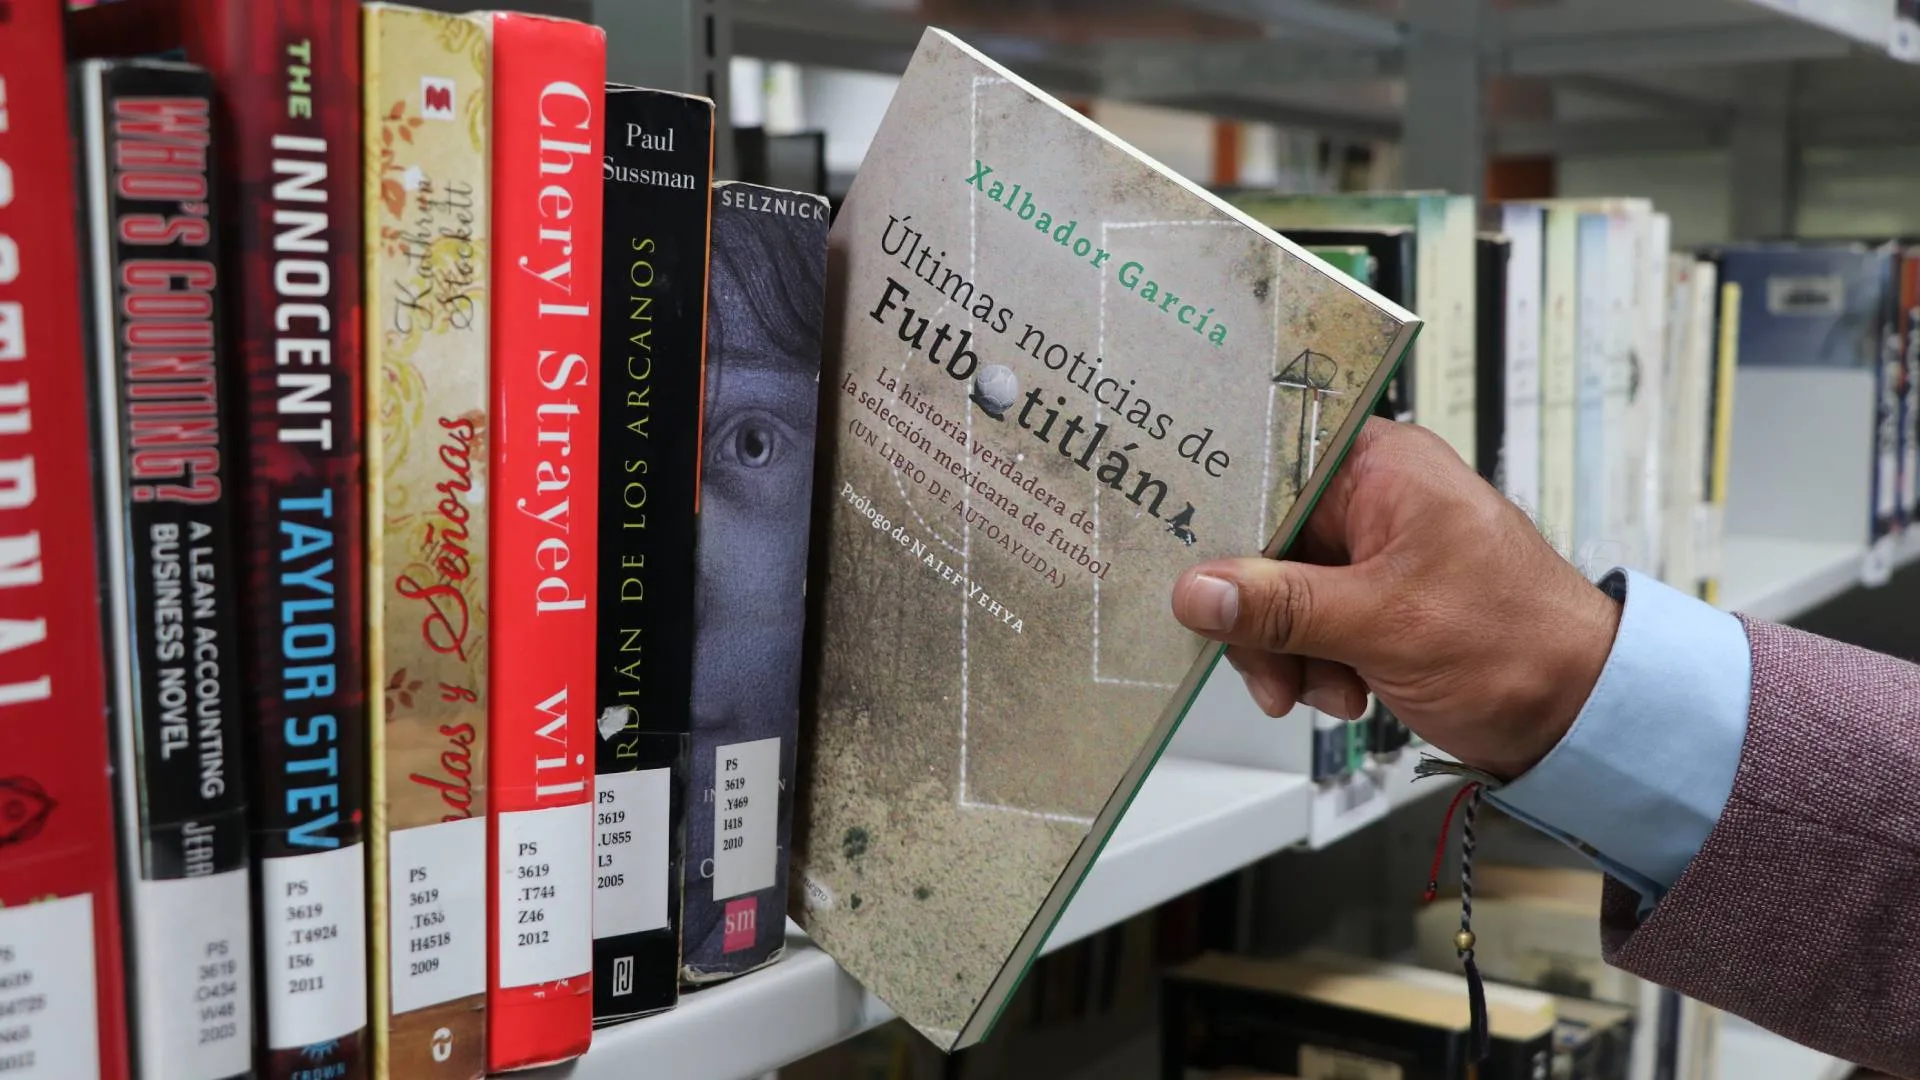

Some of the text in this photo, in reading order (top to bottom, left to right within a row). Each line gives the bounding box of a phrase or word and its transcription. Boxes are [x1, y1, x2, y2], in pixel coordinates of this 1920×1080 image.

[625, 122, 676, 152] Paul
[602, 155, 697, 190] Sussman
[721, 190, 825, 222] SELZNICK
[271, 40, 333, 451] THE INNOCENT
[394, 172, 446, 335] Kathryn
[437, 180, 474, 332] Stockett
[965, 159, 1228, 347] Xalbador García
[114, 98, 222, 504] WHO'S COUNTING?
[516, 80, 592, 617] Cheryl Strayed
[881, 215, 1230, 477] Últimas noticias de
[876, 366, 1095, 535] La historia verdadera de
[840, 372, 1112, 581] la selección mexicana de futbol
[614, 236, 656, 772] RDIÁN DE LOS ARCANOS
[848, 418, 1067, 589] (UN LIBRO DE AUTOAYUDA)
[395, 416, 475, 663] Señoras
[840, 481, 1024, 634] Prólogo de NAIEF YEHYA
[150, 522, 190, 761] BUSINESS NOVEL
[187, 520, 225, 799] A LEAN ACCOUNTING
[279, 488, 341, 849] TAYLOR STEV
[437, 681, 478, 705] y
[534, 683, 589, 802] wil
[725, 758, 739, 772] PS
[724, 777, 746, 792] 3619
[598, 790, 615, 804] PS
[723, 796, 749, 812] .Y469
[597, 811, 626, 826] 3619
[517, 841, 538, 857] PS
[597, 831, 632, 847] .U855
[722, 836, 744, 852] 2010
[517, 864, 551, 879] 3619
[597, 855, 613, 868] L3
[409, 867, 428, 883] PS
[597, 874, 625, 889] 2005
[286, 881, 309, 897] PS
[409, 888, 440, 907] 3619
[517, 885, 556, 902] .T744
[286, 903, 323, 921] 3619
[517, 909, 545, 924] Z46
[725, 908, 756, 935] sm
[286, 924, 338, 945] .T4924
[410, 932, 452, 953] H4518
[517, 930, 550, 947] 2012
[410, 957, 440, 977] 2009
[288, 975, 325, 995] 2011
